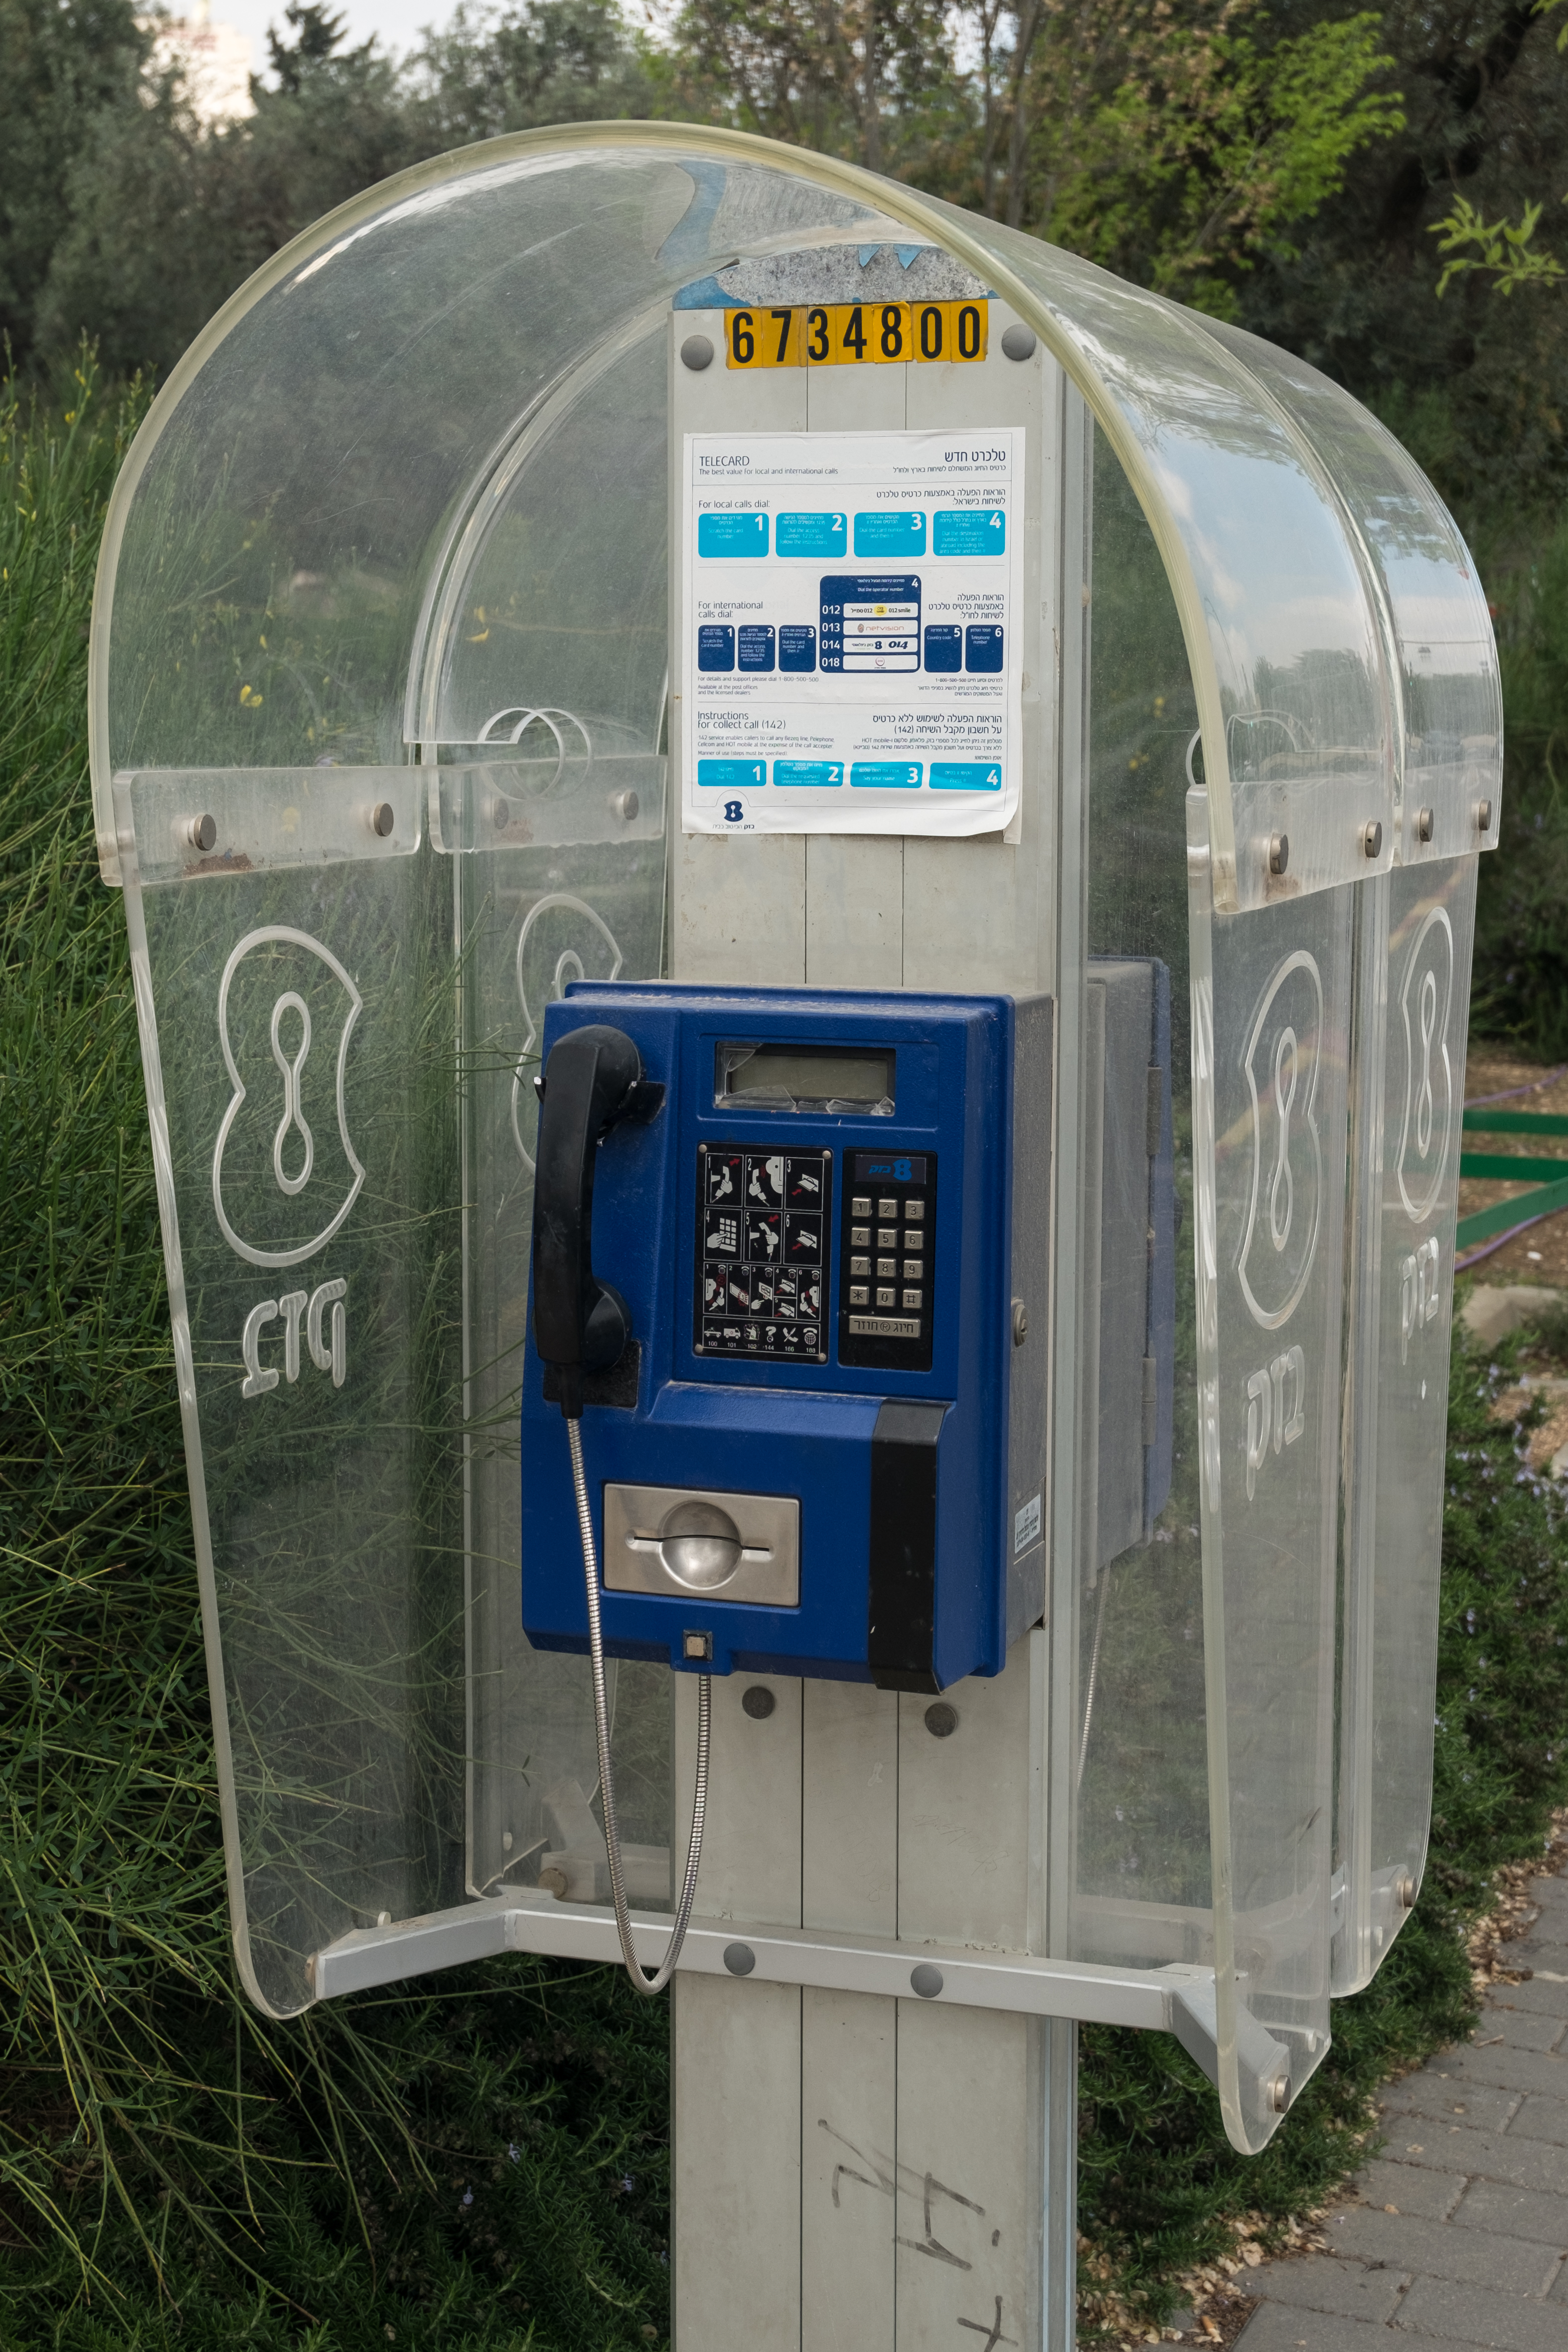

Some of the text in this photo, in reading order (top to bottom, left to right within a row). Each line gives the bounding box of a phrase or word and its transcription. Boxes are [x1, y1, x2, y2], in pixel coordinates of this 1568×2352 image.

[732, 306, 980, 363] 6734800
[945, 448, 1005, 462] טלכרט חדש
[699, 456, 749, 466] TELECARD
[755, 515, 763, 530] 1
[831, 514, 842, 531] 2
[911, 513, 922, 530] 3
[989, 512, 1001, 528] 4
[912, 578, 918, 587] 4
[822, 605, 840, 614] 012
[727, 627, 732, 636] 1
[767, 627, 773, 636] 2
[822, 623, 839, 631] 013
[954, 627, 960, 637] 5
[995, 627, 1001, 636] 6
[808, 628, 814, 637] 3
[822, 640, 840, 649] 014
[888, 640, 908, 649] 014
[822, 657, 839, 666] 018
[698, 711, 748, 720] Instructions
[898, 714, 913, 722] ללא
[917, 713, 944, 722] לשימוש
[947, 713, 973, 722] הפעלה
[698, 720, 785, 729] for collect call (142)
[894, 725, 914, 734] (142)
[943, 724, 965, 735] מקבל
[991, 725, 1001, 734] על
[968, 726, 988, 735] חשבון
[753, 766, 760, 781] 1
[828, 766, 838, 781] 2
[907, 767, 918, 783] 3
[986, 770, 998, 785] 4
[708, 1156, 710, 1168] 1
[748, 1158, 751, 1170] 2
[787, 1159, 791, 1172] 3
[868, 1165, 891, 1174] בזק
[858, 1203, 862, 1212] 1
[884, 1204, 889, 1214] 2
[911, 1206, 917, 1216] 3
[706, 1210, 709, 1222] 4
[746, 1212, 749, 1225] 5
[786, 1214, 789, 1227] 6
[856, 1232, 862, 1242] 4
[883, 1234, 888, 1243] 5
[910, 1235, 915, 1245] 6
[856, 1261, 862, 1270] 7
[882, 1263, 888, 1272] 8
[909, 1265, 915, 1274] 9
[881, 1292, 888, 1302] 0
[854, 1321, 913, 1333] חיוג חוזר
